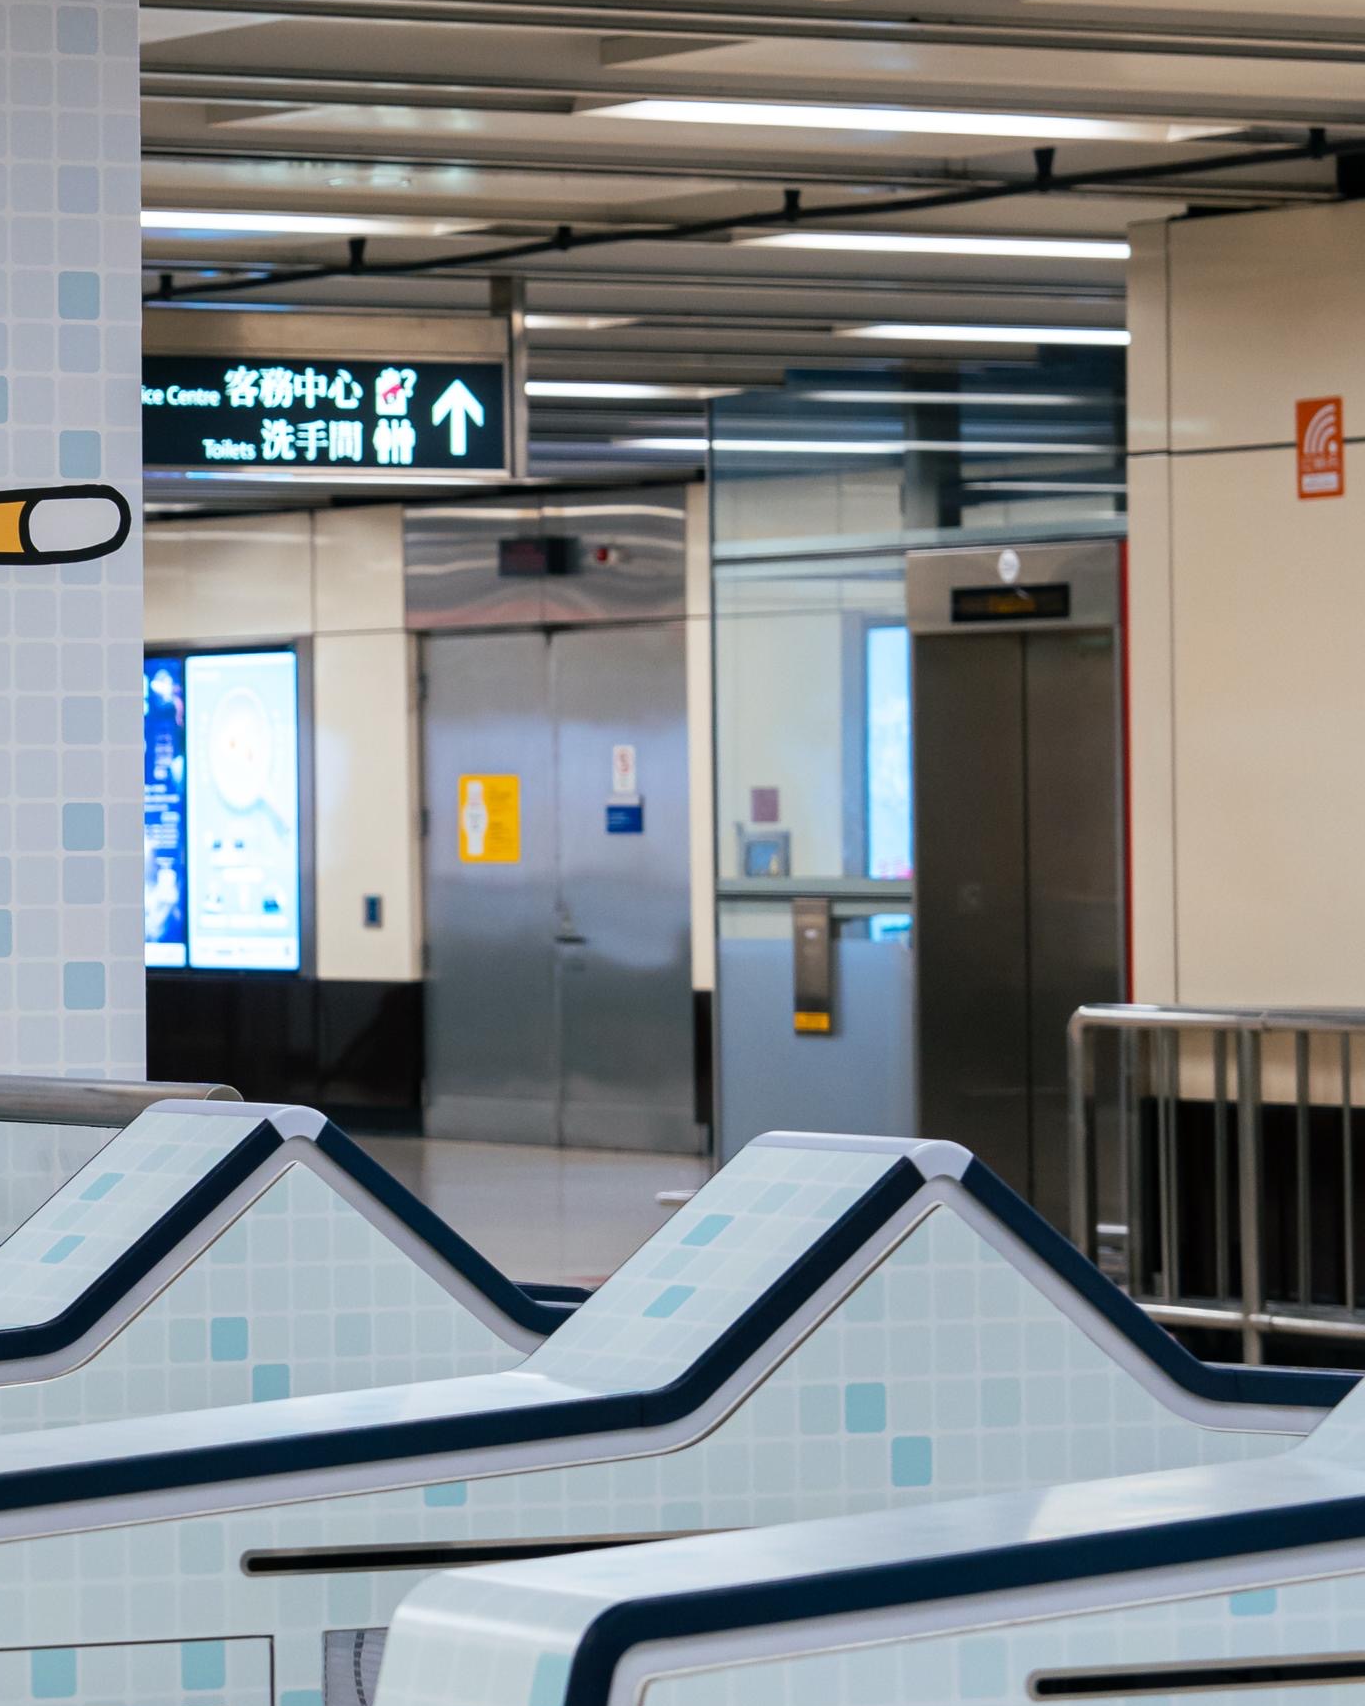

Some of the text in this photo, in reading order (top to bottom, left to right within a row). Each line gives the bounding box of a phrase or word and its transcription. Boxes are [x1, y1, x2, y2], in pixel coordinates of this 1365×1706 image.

[166, 385, 221, 407] Centre
[224, 366, 364, 409] 客務中心
[202, 438, 257, 461] Toilets
[260, 418, 364, 462] 洗手間
